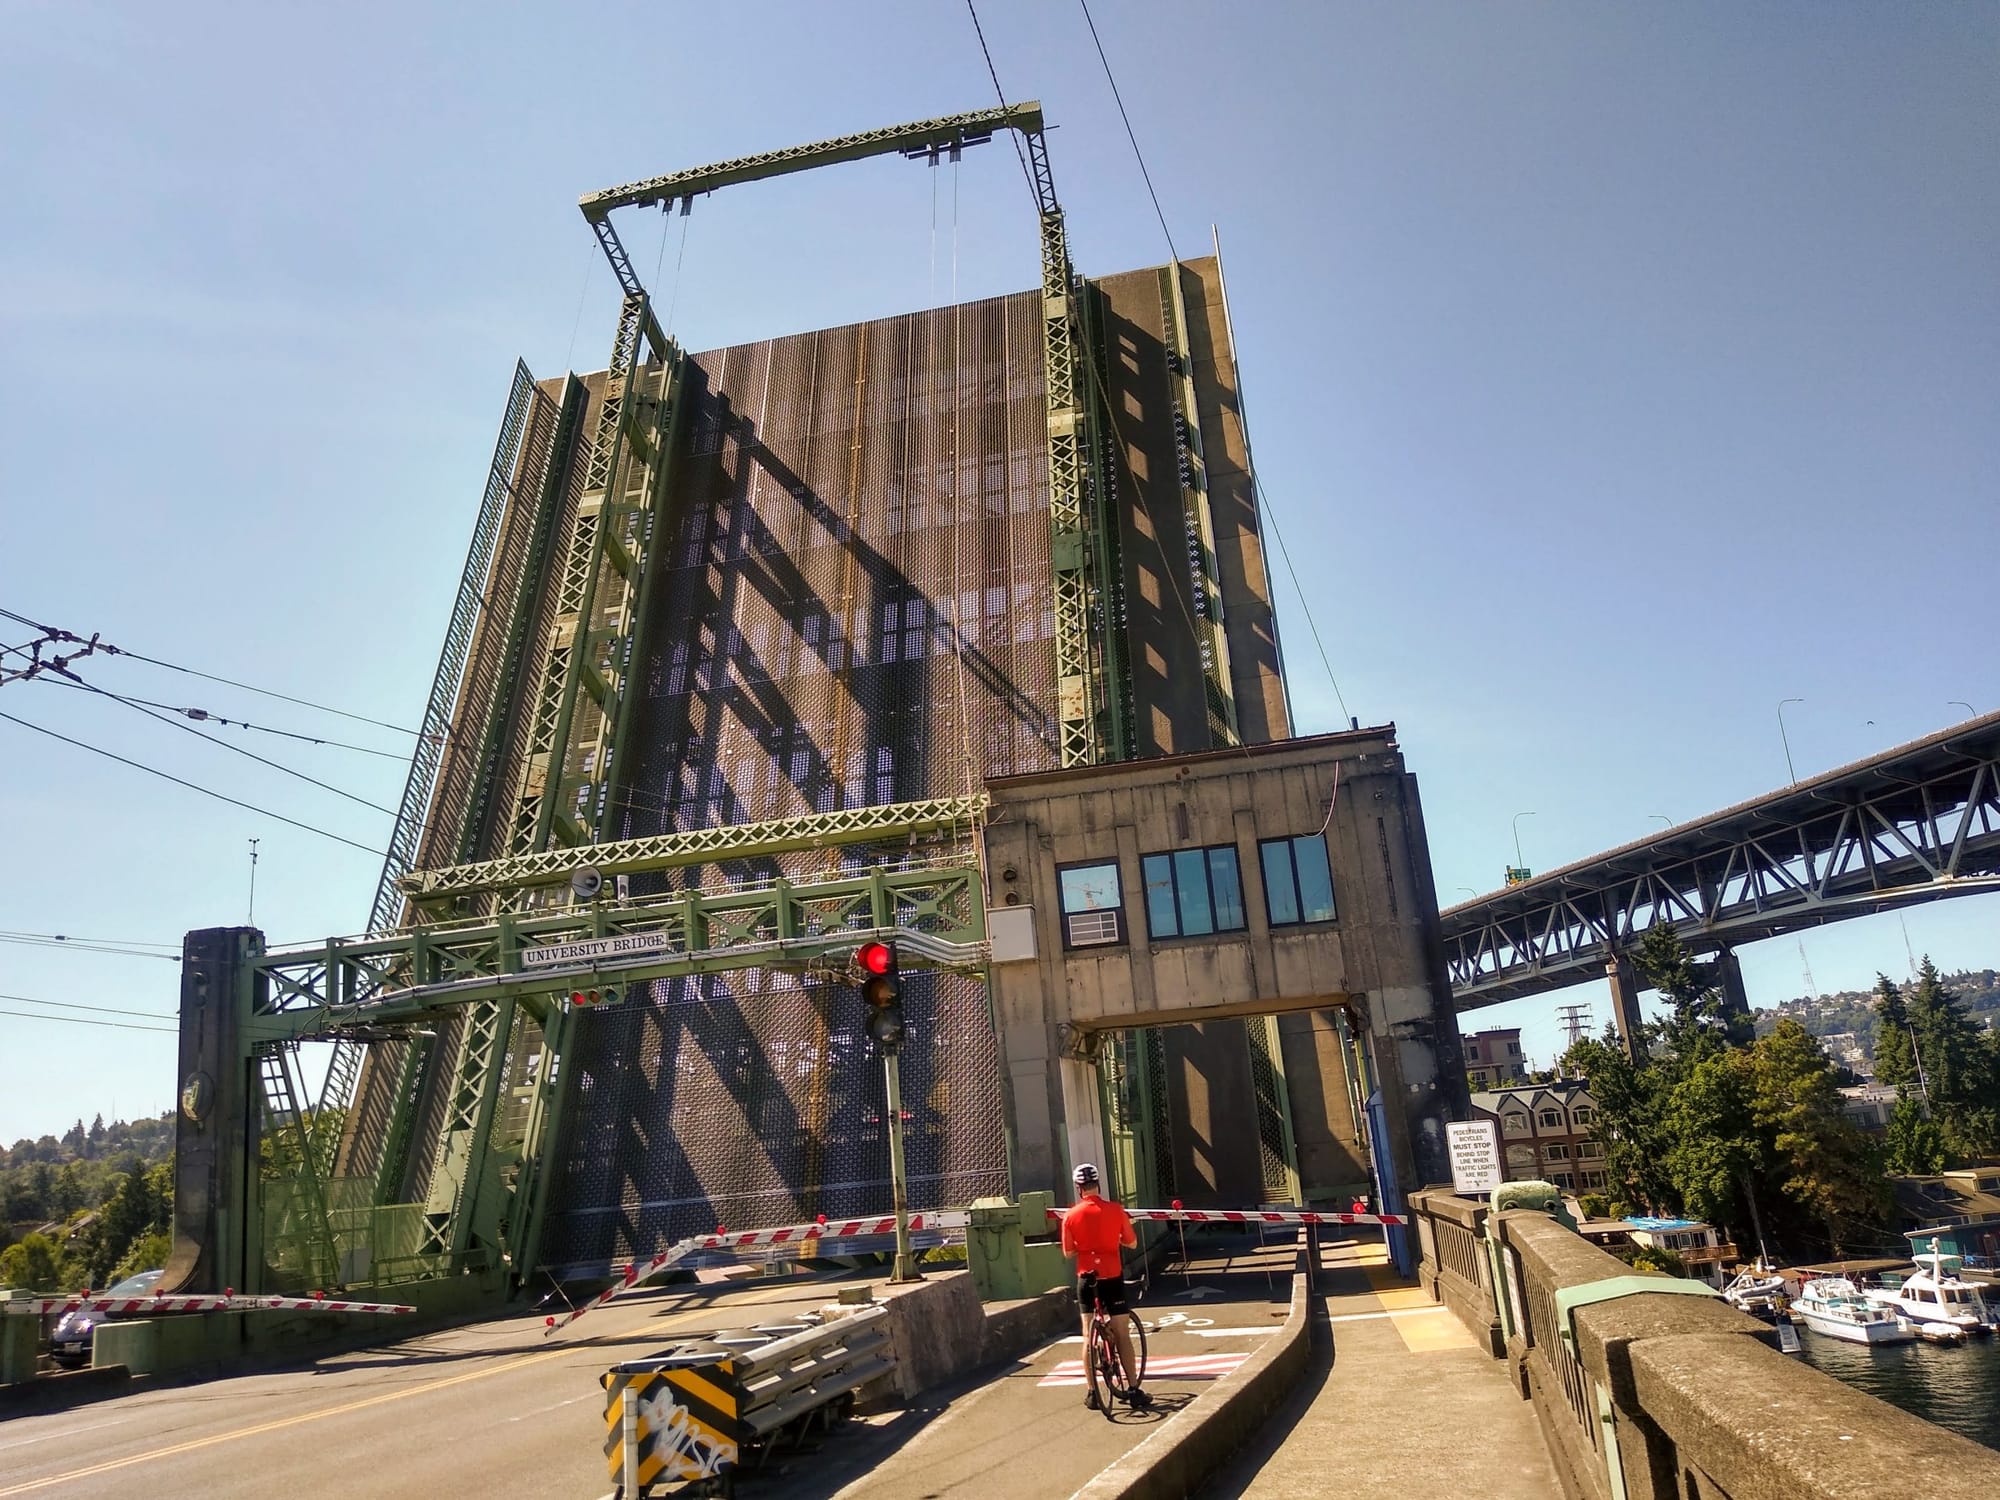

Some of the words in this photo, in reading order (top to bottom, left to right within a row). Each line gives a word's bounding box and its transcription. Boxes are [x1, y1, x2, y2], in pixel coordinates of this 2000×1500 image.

[527, 941, 608, 963] UNIVERSITY
[614, 935, 665, 952] BRIDGE
[1453, 1128, 1487, 1136] PEDESTRIANS
